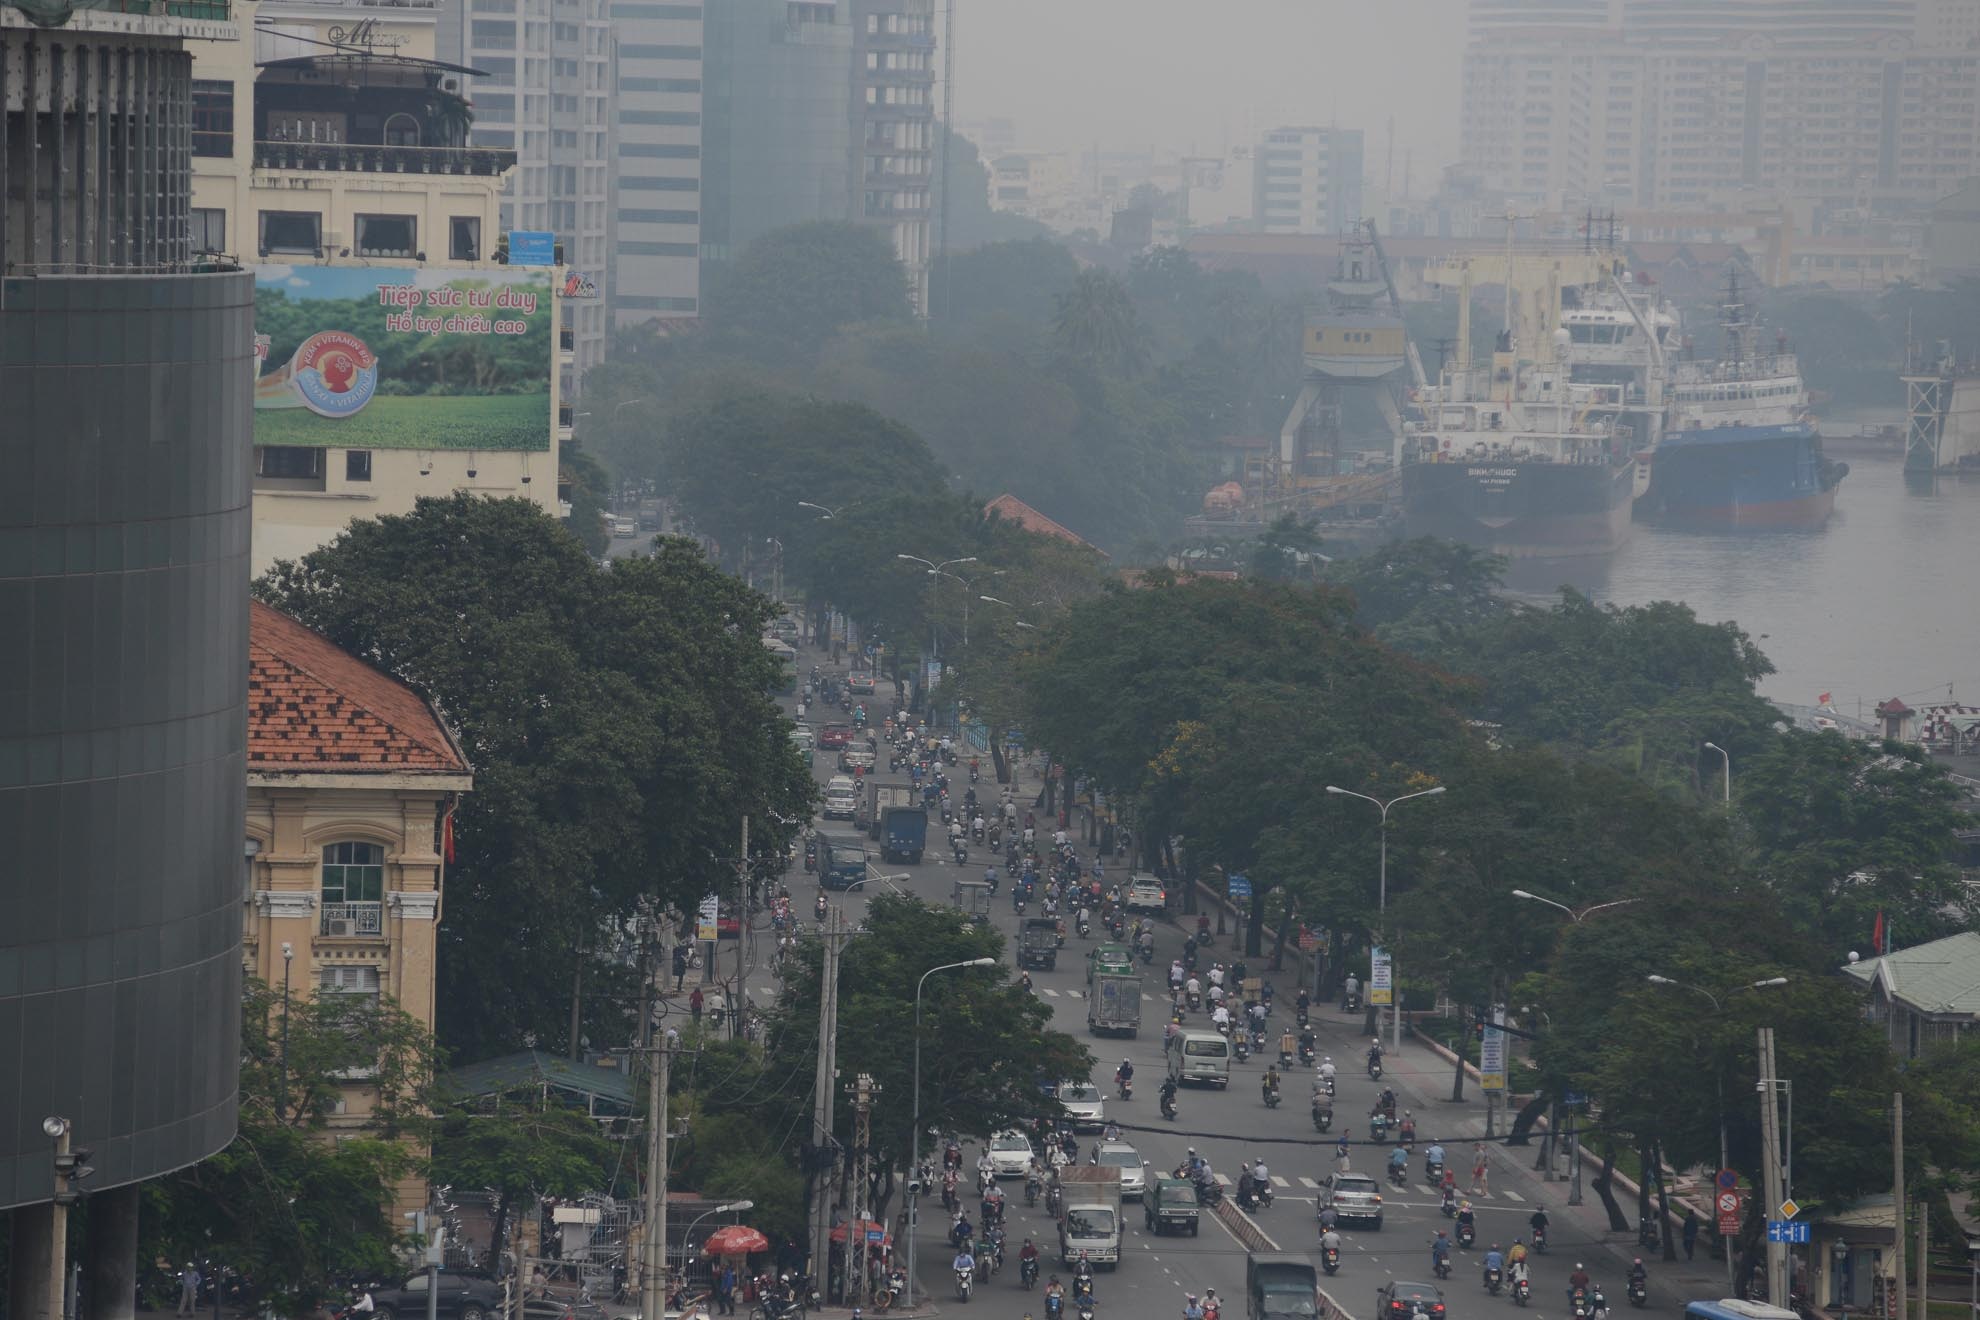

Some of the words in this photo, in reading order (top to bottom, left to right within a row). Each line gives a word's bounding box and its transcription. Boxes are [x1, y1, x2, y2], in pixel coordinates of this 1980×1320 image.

[378, 285, 421, 311] Tiếp
[428, 287, 462, 305] sức
[468, 290, 492, 306] tư
[497, 287, 536, 313] duy
[387, 312, 411, 331] Hỗ
[417, 316, 442, 335] trợ
[446, 314, 490, 332] chiều
[495, 320, 526, 333] cao
[321, 335, 360, 350] VITAMIN
